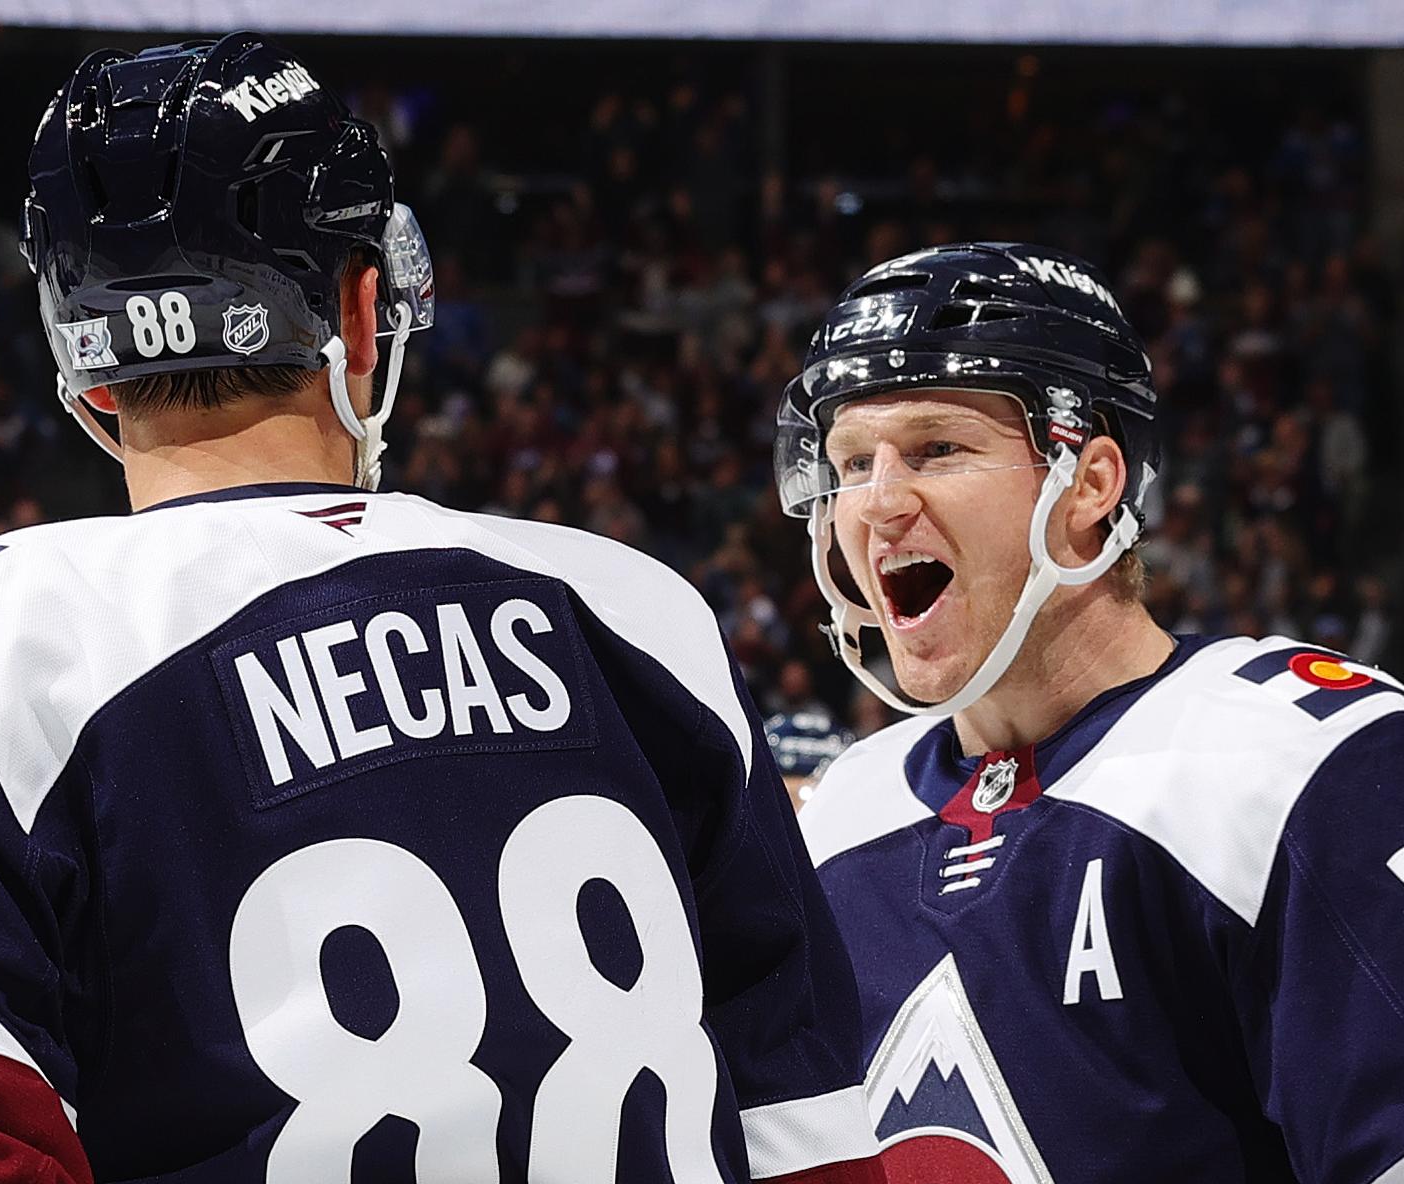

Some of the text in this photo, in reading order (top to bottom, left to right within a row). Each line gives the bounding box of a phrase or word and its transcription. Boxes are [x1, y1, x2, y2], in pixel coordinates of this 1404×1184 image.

[125, 291, 196, 358] 88
[233, 598, 571, 786] NECAS
[1062, 858, 1124, 1005] A
